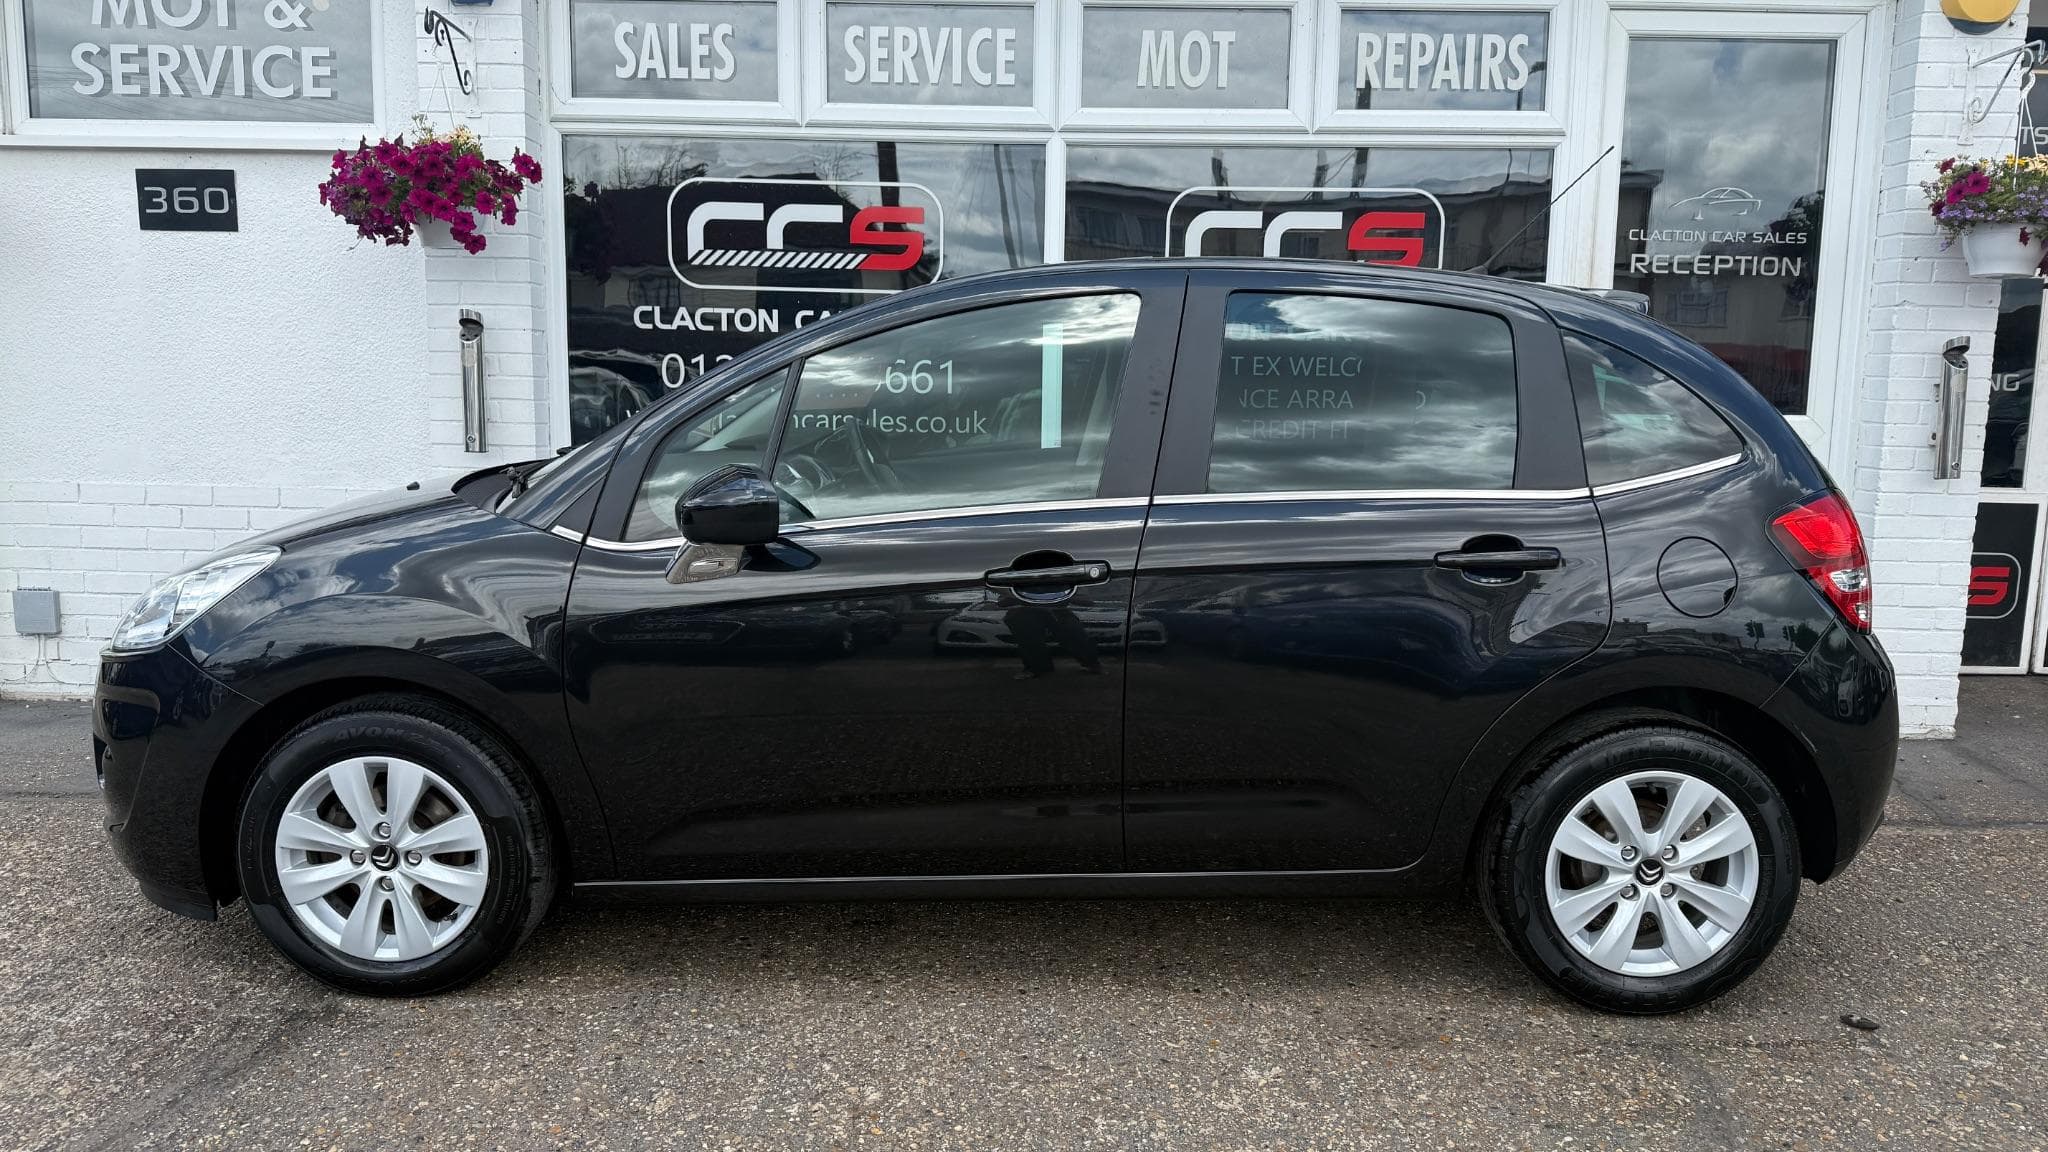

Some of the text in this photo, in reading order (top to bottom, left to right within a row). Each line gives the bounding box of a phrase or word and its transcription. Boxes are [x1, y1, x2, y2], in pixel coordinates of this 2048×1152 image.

[264, 0, 307, 29] &
[614, 21, 735, 80] SALES
[844, 25, 1016, 86] SERVICE
[1137, 29, 1236, 88] MOT
[1356, 32, 1529, 91] REPAIRS
[71, 42, 332, 98] SERVICE
[144, 186, 230, 214] 360
[687, 201, 925, 271] CCS
[1629, 228, 1808, 245] CLACTON CAR SALES
[1630, 253, 1802, 277] RECEPTION
[633, 305, 779, 333] CLACTON
[661, 353, 734, 389] 01
[1253, 356, 1282, 376] EX
